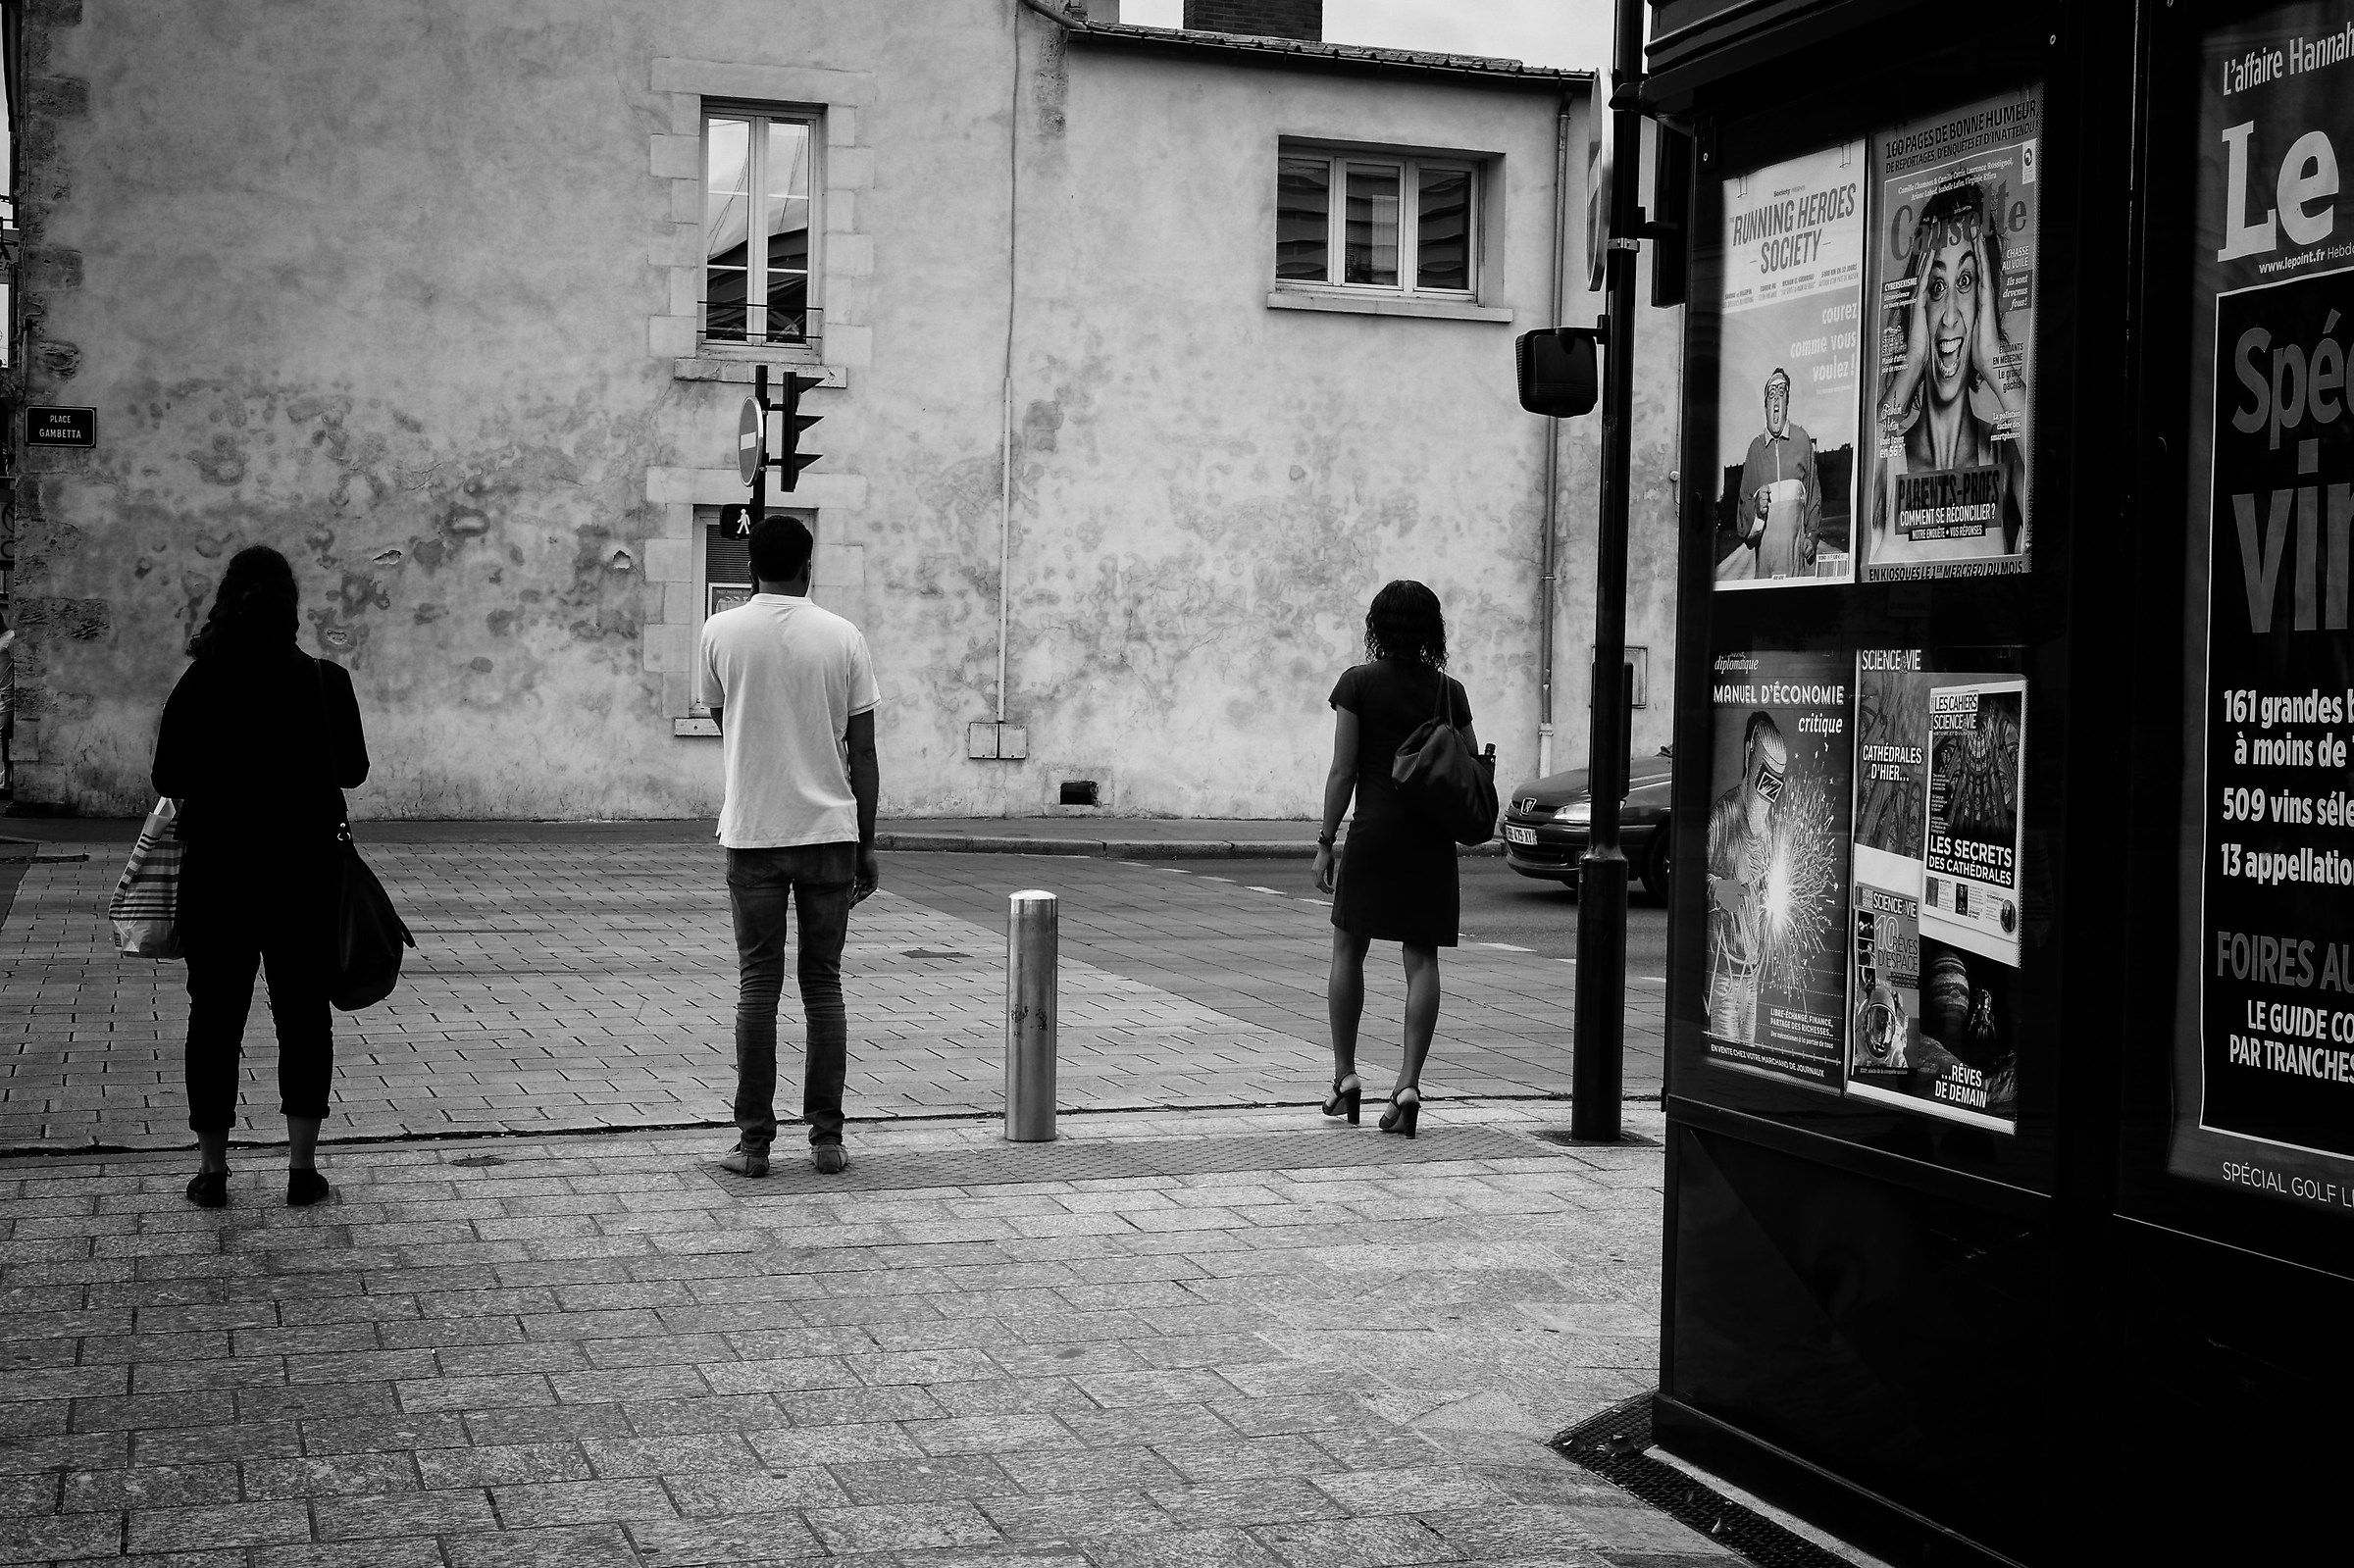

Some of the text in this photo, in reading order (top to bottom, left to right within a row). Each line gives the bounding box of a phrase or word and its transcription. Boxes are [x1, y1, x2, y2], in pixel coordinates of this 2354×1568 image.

[2223, 46, 2283, 96] L'affaire
[1905, 130, 1934, 154] PAGES
[1935, 125, 1949, 146] DE
[1950, 113, 1984, 140] BONNE
[1885, 161, 1895, 175] DE
[1895, 149, 1937, 172] REPORTAGES,
[1937, 137, 1975, 160] D'ENQUÊTES
[1974, 134, 1983, 146] ET
[1773, 187, 1791, 197] Society
[2217, 120, 2339, 263] Le
[1733, 182, 1857, 246] RUNNING HEROES
[1890, 179, 2027, 261] Causette
[1761, 228, 1822, 274] SOCIETY
[2006, 245, 2030, 259] CHASSE
[2259, 248, 2326, 275] www.lepoint.fr
[2002, 260, 2011, 272] AU
[2015, 275, 2028, 284] sont
[2002, 287, 2028, 299] devenus
[1821, 302, 1857, 325] courez
[1790, 330, 1857, 359] comme vous
[1813, 354, 1849, 382] voulez
[1992, 356, 2000, 366] EN
[1998, 366, 2022, 381] Le grand
[2231, 308, 2354, 451] Spé
[50, 415, 72, 424] PLACE
[39, 429, 81, 439] GAMBETTA
[1900, 507, 1935, 527] COMMENT
[1935, 507, 1945, 524] SE
[1912, 524, 1983, 540] NOTRE ENQUÊTE VOS RÉPONSES
[1869, 568, 1879, 581] EN
[1881, 566, 1920, 581] KIOSQUES
[1921, 565, 1931, 579] LE
[1943, 563, 1987, 579] MERCREDI
[1988, 562, 2000, 577] DU
[2002, 560, 2022, 576] MOIS
[1714, 654, 1759, 675] diplomatique
[1713, 680, 1845, 705] MANUEL D'ÉCONOMIE
[1935, 694, 1977, 711] LES CAHIERS
[2224, 688, 2343, 729] 161 grandes
[1798, 712, 1843, 737] critique
[1863, 742, 1922, 765] CATHÉDRALES
[2234, 731, 2347, 768] à moins de
[1870, 763, 1910, 782] D'HIER...
[2223, 787, 2266, 822] 509
[2270, 788, 2313, 825] vins
[1930, 835, 2013, 868] LES SECRETS
[2221, 842, 2354, 886] 13 appellatio
[1928, 855, 2012, 885] DES CATHÉDRALES
[1875, 914, 1899, 952] 10
[1893, 934, 1919, 955] RÊVES
[1878, 949, 1919, 972] D'ESPACE
[2217, 931, 2316, 988] FOIRES
[1770, 1007, 1834, 1029] LIBRE-ÉCHANGE, FINANCE,
[1770, 1017, 1792, 1030] PARTAGE
[1792, 1021, 1802, 1032] DES
[2247, 999, 2267, 1032] LE
[2269, 1002, 2328, 1040] GUIDE
[1711, 1043, 1825, 1078] EN VENTE CHEZ VOTRE MARCHAND DE JOURNAUX
[2229, 1034, 2262, 1069] PAR
[1941, 1062, 1982, 1087] ...RÊVES
[1934, 1080, 1987, 1109] DE DEMAIN
[2222, 1161, 2287, 1193] SPÉCIAL
[2290, 1176, 2336, 1203] GOLF
